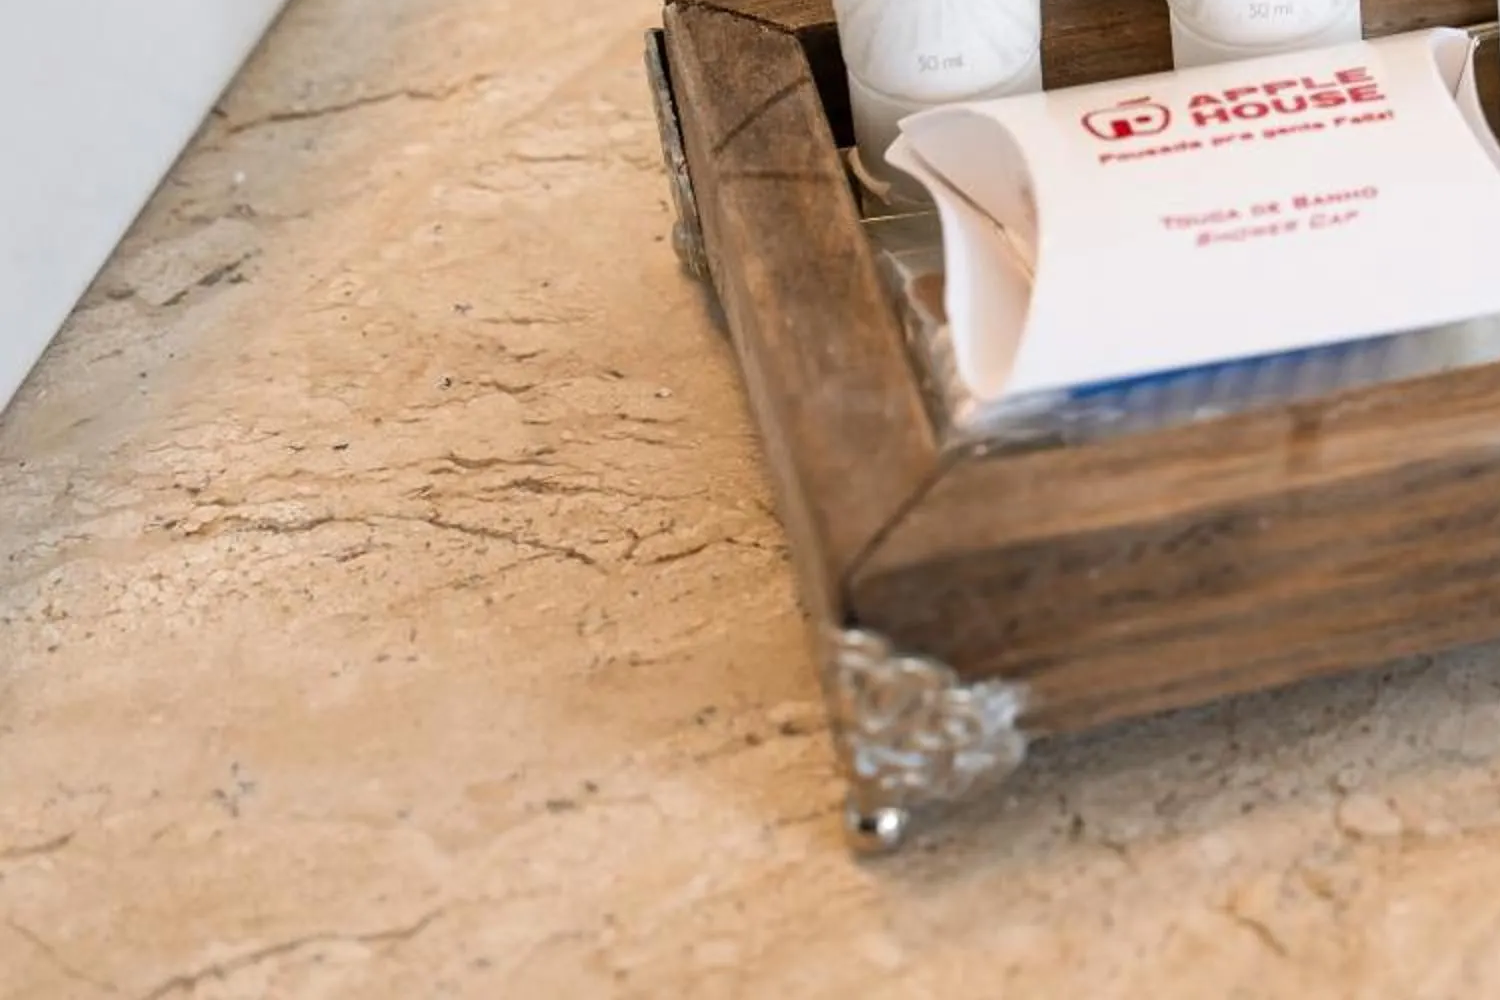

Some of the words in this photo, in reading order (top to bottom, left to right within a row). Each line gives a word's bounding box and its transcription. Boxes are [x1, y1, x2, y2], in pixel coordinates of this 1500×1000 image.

[1188, 66, 1374, 109] APPLE
[1192, 83, 1386, 127] HOUSE
[1099, 138, 1202, 164] Pousada
